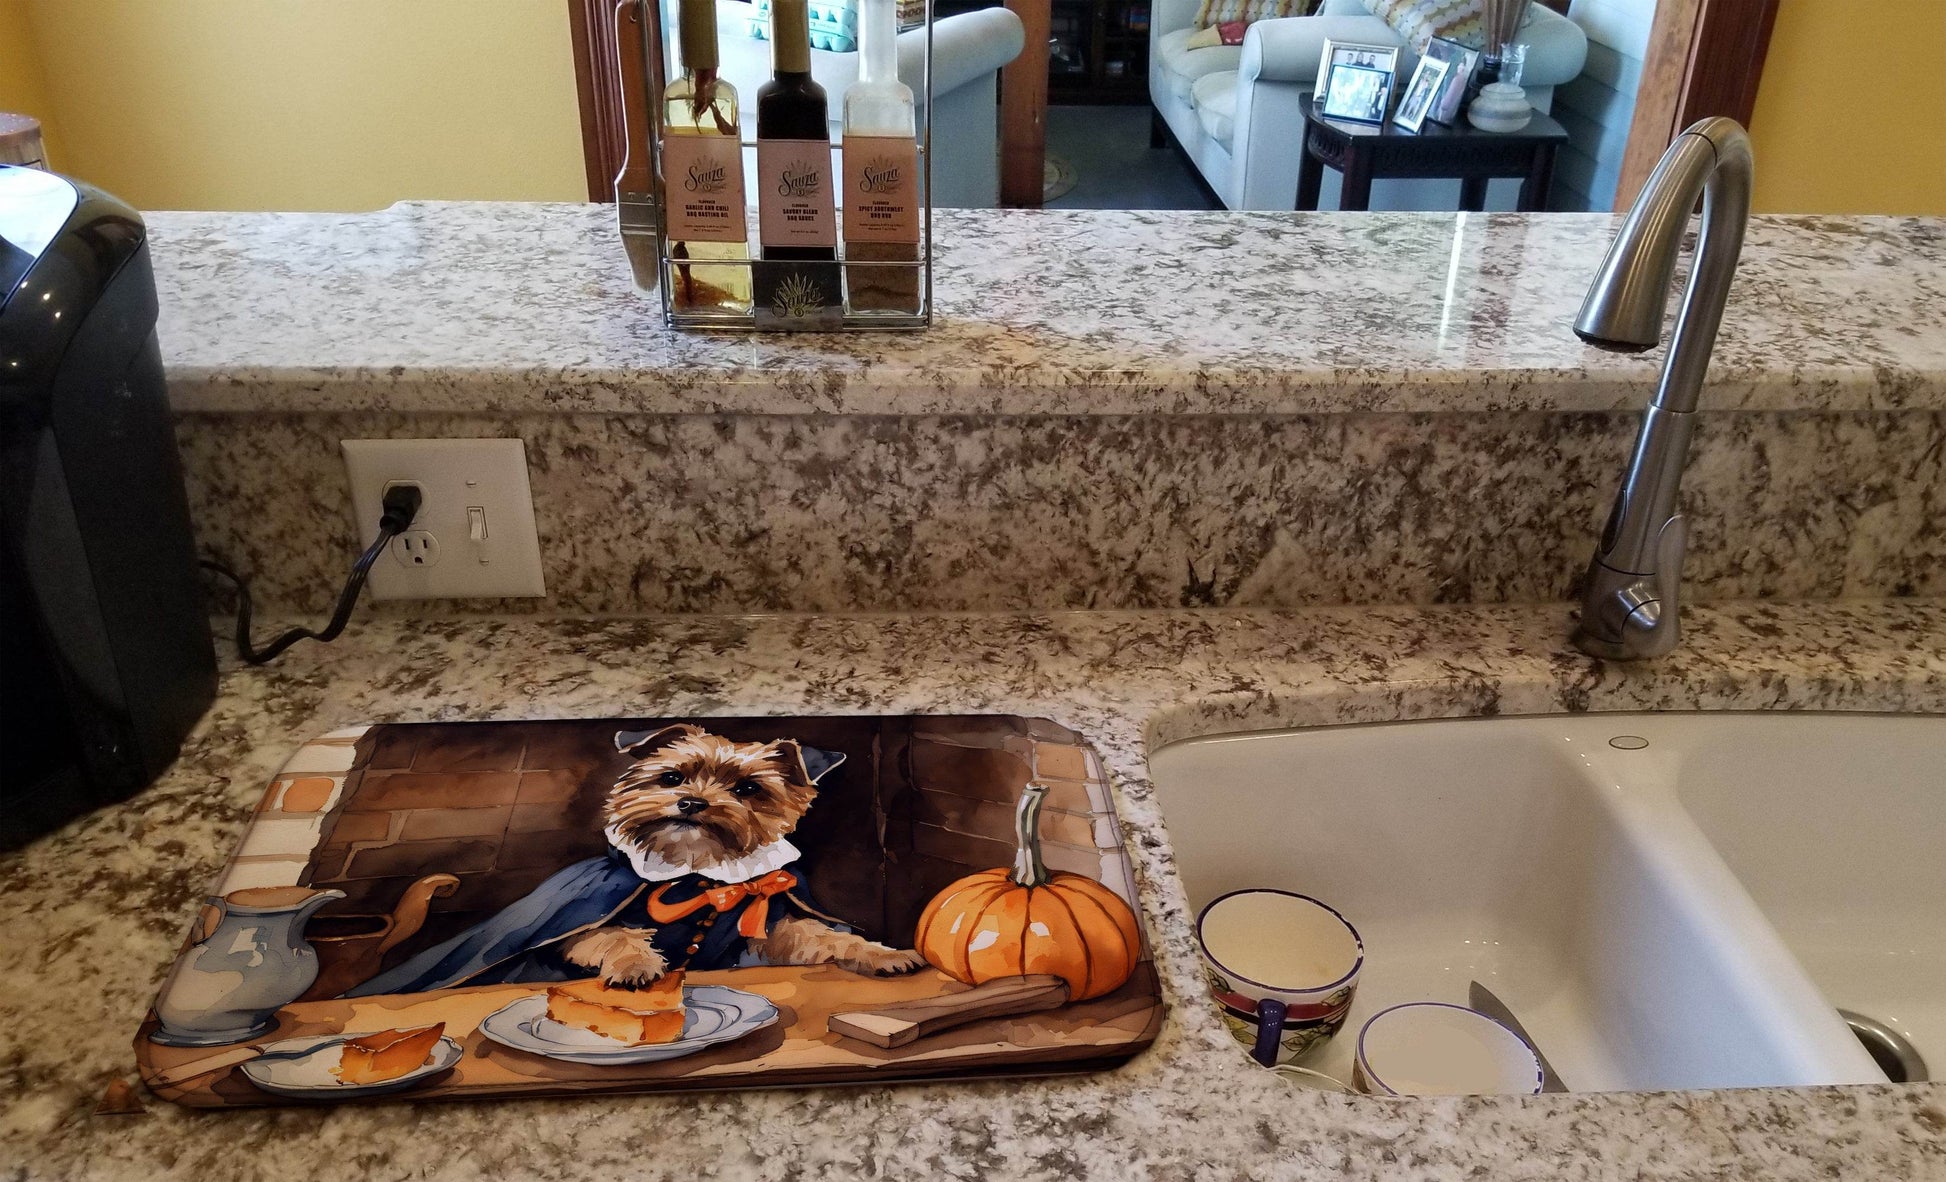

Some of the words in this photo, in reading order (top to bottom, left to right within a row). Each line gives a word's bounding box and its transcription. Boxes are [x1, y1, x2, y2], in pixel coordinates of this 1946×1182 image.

[684, 165, 727, 192] Sauza
[778, 170, 820, 197] Sauza
[859, 166, 901, 193] Sauza
